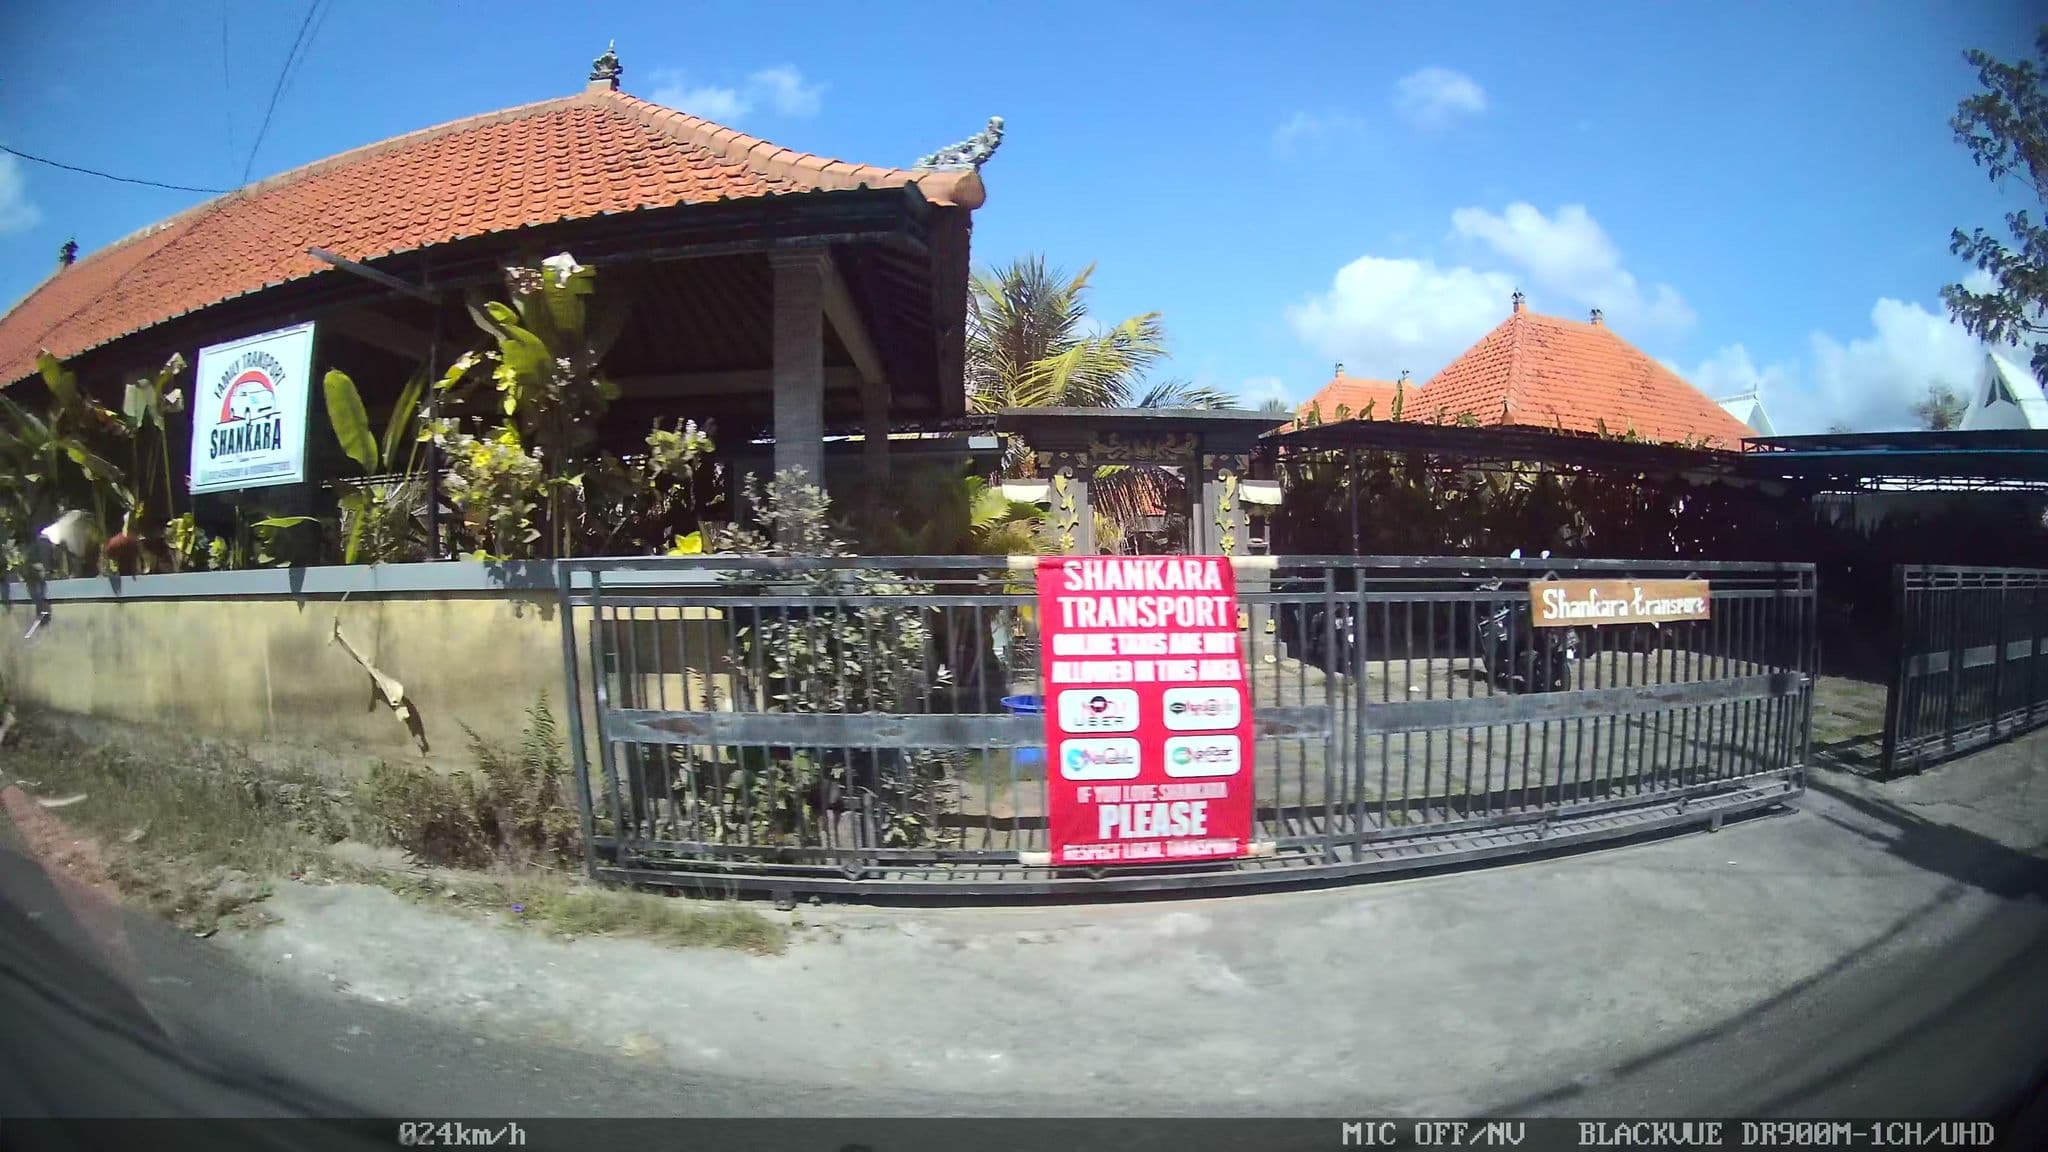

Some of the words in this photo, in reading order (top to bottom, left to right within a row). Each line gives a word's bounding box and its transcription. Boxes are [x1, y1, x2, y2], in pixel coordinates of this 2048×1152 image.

[210, 419, 281, 459] SHANKARA
[1063, 559, 1223, 591] SHANKARA
[1056, 596, 1232, 628] TRANSPORT
[1099, 801, 1208, 839] PLEASE
